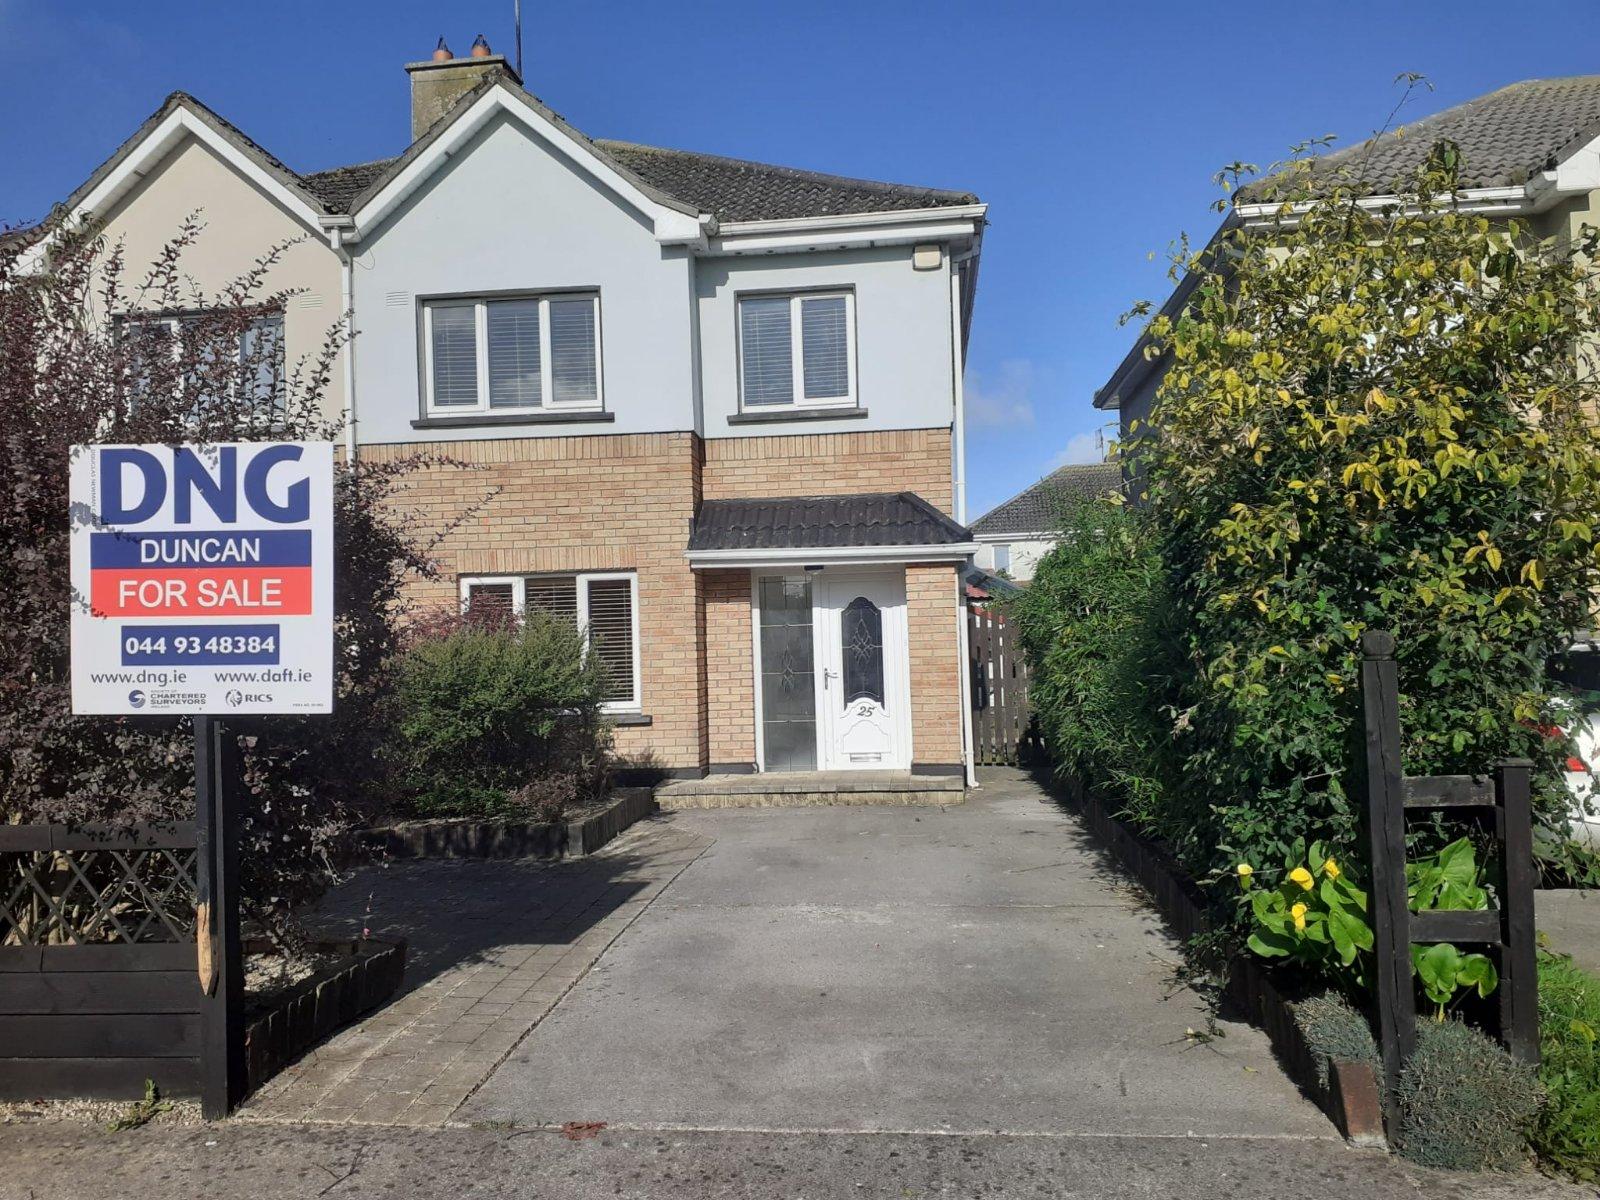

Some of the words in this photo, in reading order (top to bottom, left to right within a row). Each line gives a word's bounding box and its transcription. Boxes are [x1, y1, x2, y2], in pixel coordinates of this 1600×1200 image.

[99, 444, 311, 525] DNG
[140, 538, 260, 563] DUNCAN
[118, 580, 188, 608] FOR
[197, 578, 282, 608] SALE
[125, 637, 167, 655] 044
[173, 636, 201, 655] 93
[204, 635, 275, 654] 48384
[90, 670, 188, 687] www.dng.ie
[214, 668, 313, 683] www.daft.ie
[245, 693, 273, 703] RICS
[857, 705, 877, 717] 25
